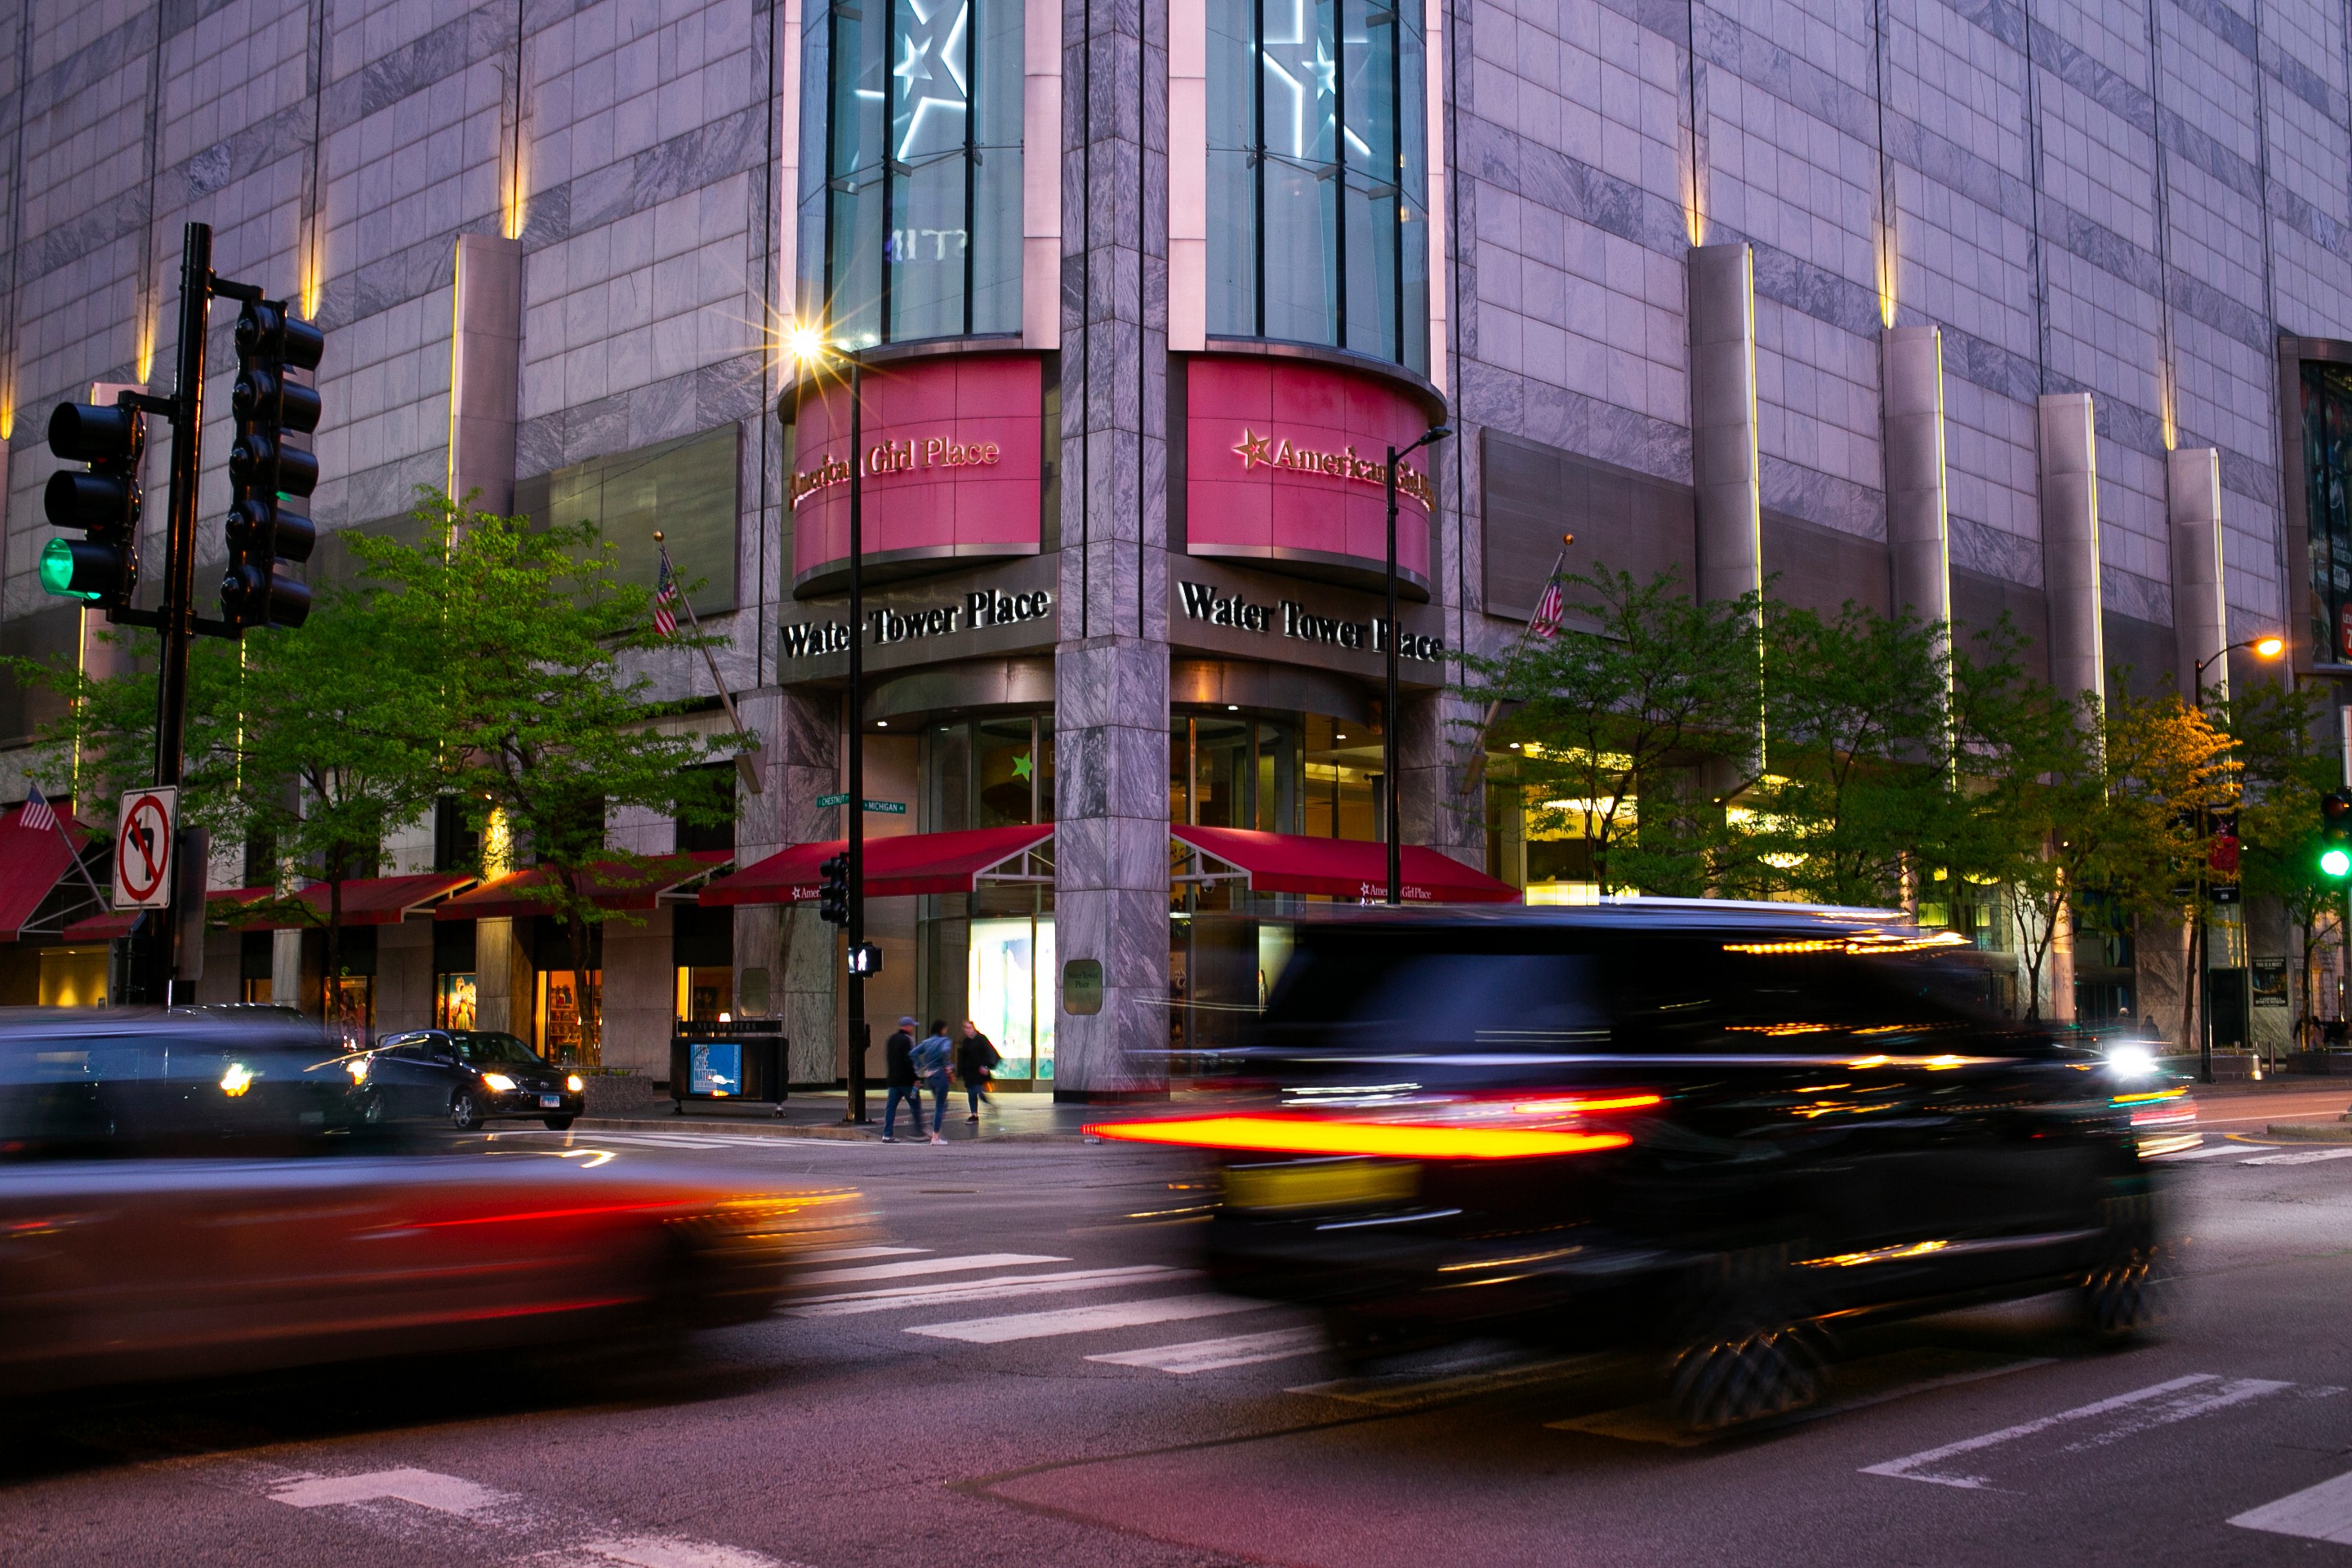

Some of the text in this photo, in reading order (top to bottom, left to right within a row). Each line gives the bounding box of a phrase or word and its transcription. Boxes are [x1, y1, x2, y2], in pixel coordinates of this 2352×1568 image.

[866, 439, 914, 474] Girl
[921, 436, 1000, 467] Place
[1275, 439, 1390, 485] American
[781, 588, 1052, 658] Wate Tower Place
[1178, 581, 1445, 662] Water Tower Place
[822, 795, 844, 806] CHESTNUT
[868, 801, 898, 812] MICHIGAN
[1402, 886, 1414, 898] Girl
[1414, 887, 1432, 899] Place
[1067, 971, 1098, 979] Water Tower
[1075, 980, 1089, 988] Place
[697, 1022, 756, 1031] NEWSPAPERS
[694, 1070, 716, 1082] NATION
